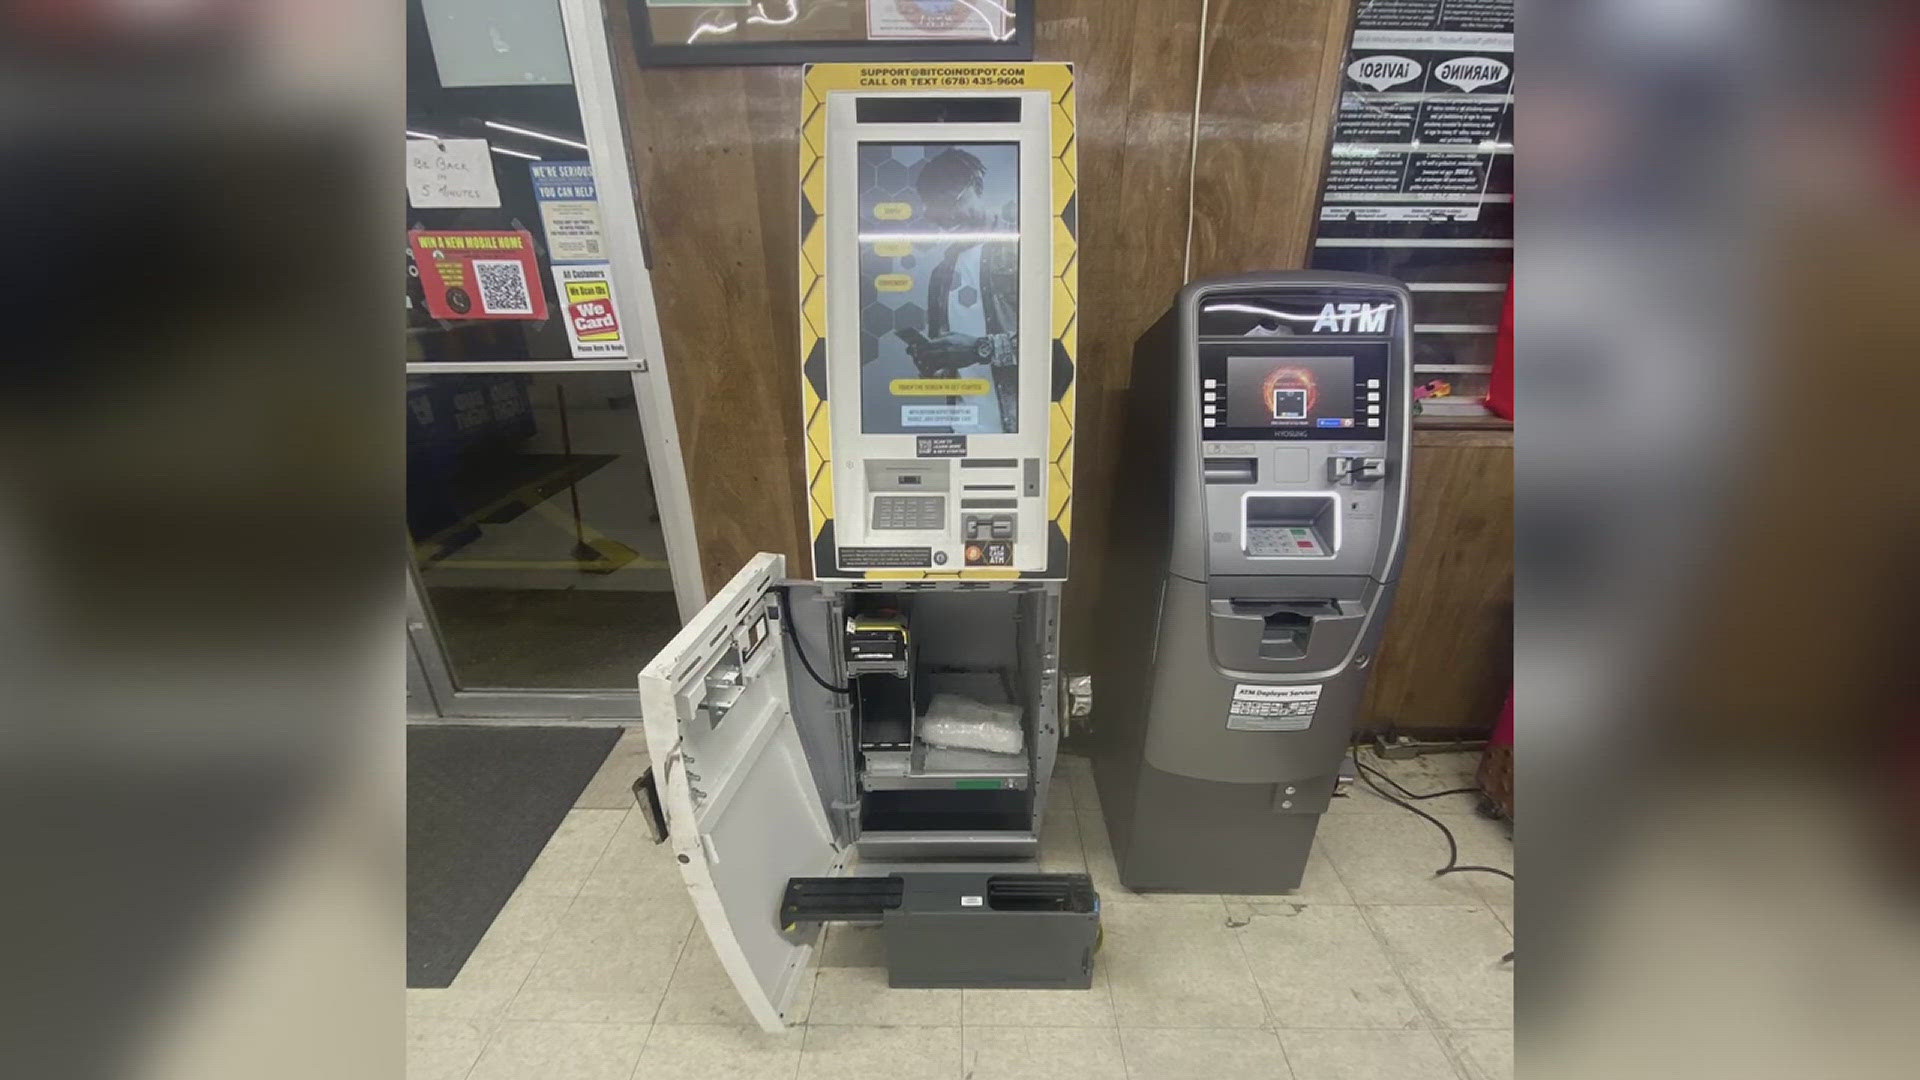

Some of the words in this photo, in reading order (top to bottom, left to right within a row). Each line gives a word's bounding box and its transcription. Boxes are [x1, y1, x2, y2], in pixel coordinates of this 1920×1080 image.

[860, 68, 1025, 77] SUPPORT@BITCOINDEPOT.COM
[860, 78, 888, 86] CALL
[891, 78, 907, 86] OR
[911, 77, 938, 86] TEXT
[941, 77, 970, 87] (678)
[972, 77, 1025, 86] 435-9604
[539, 186, 556, 197] YOU
[557, 186, 573, 197] CAN
[573, 186, 594, 197] HELP
[418, 236, 437, 248] WIN
[437, 236, 445, 248] A
[444, 236, 465, 248] NEW
[464, 236, 498, 248] MOBILE
[497, 236, 524, 248] HOME
[572, 270, 605, 278] Customers
[576, 303, 605, 317] We
[574, 313, 615, 331] Card
[1312, 303, 1389, 332] ATM
